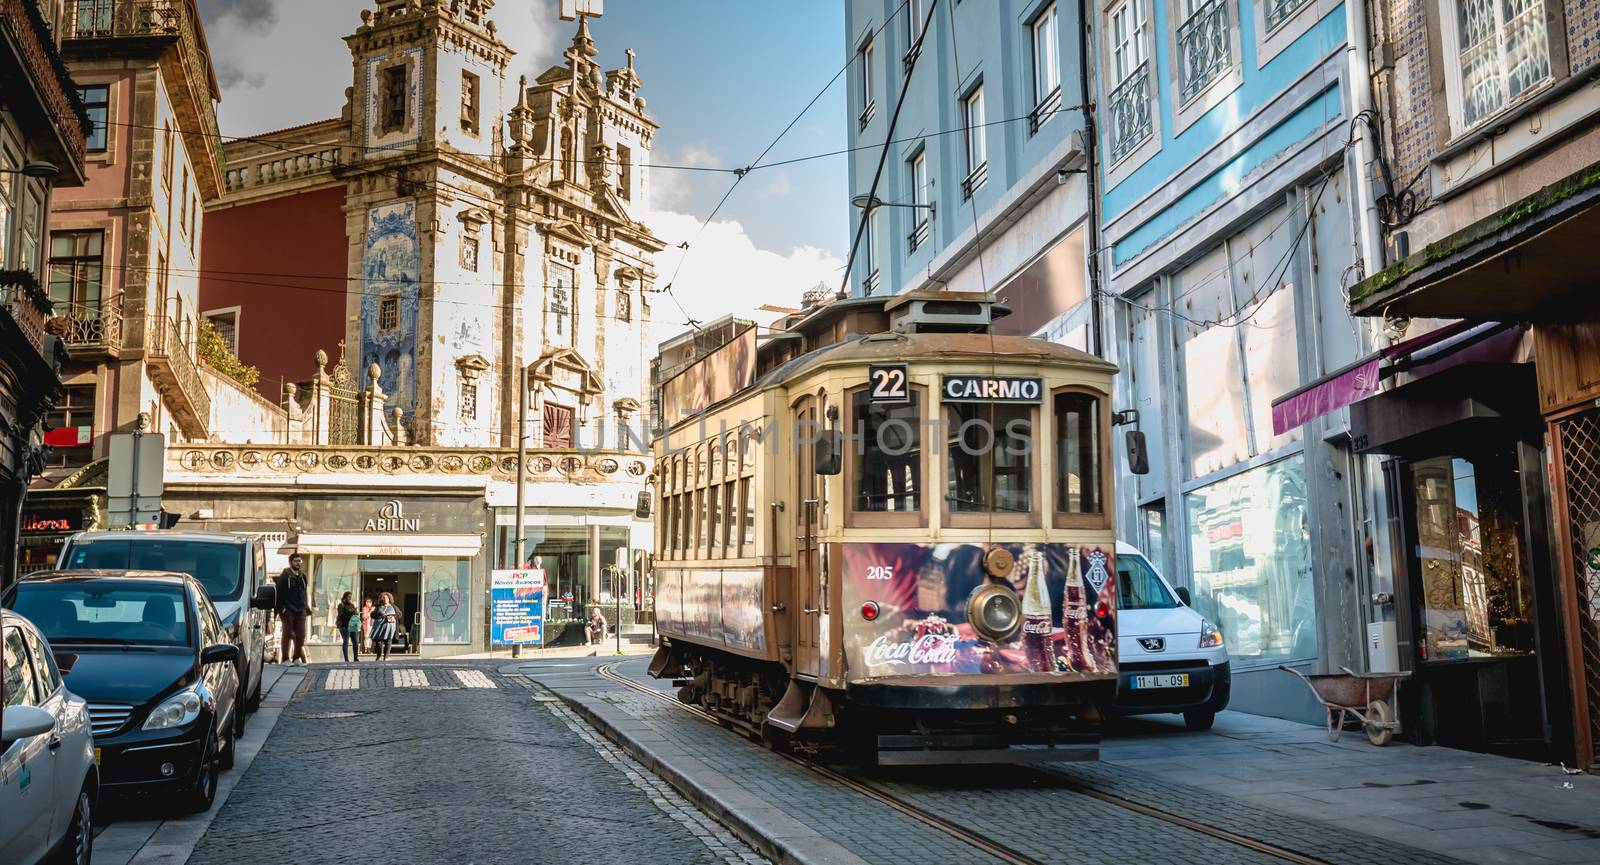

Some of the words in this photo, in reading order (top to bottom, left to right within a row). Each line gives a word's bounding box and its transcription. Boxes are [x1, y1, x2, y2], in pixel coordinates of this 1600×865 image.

[872, 369, 906, 398] 22
[946, 378, 1039, 399] CARMO
[364, 517, 420, 532] ABILINI
[866, 565, 893, 580] 205
